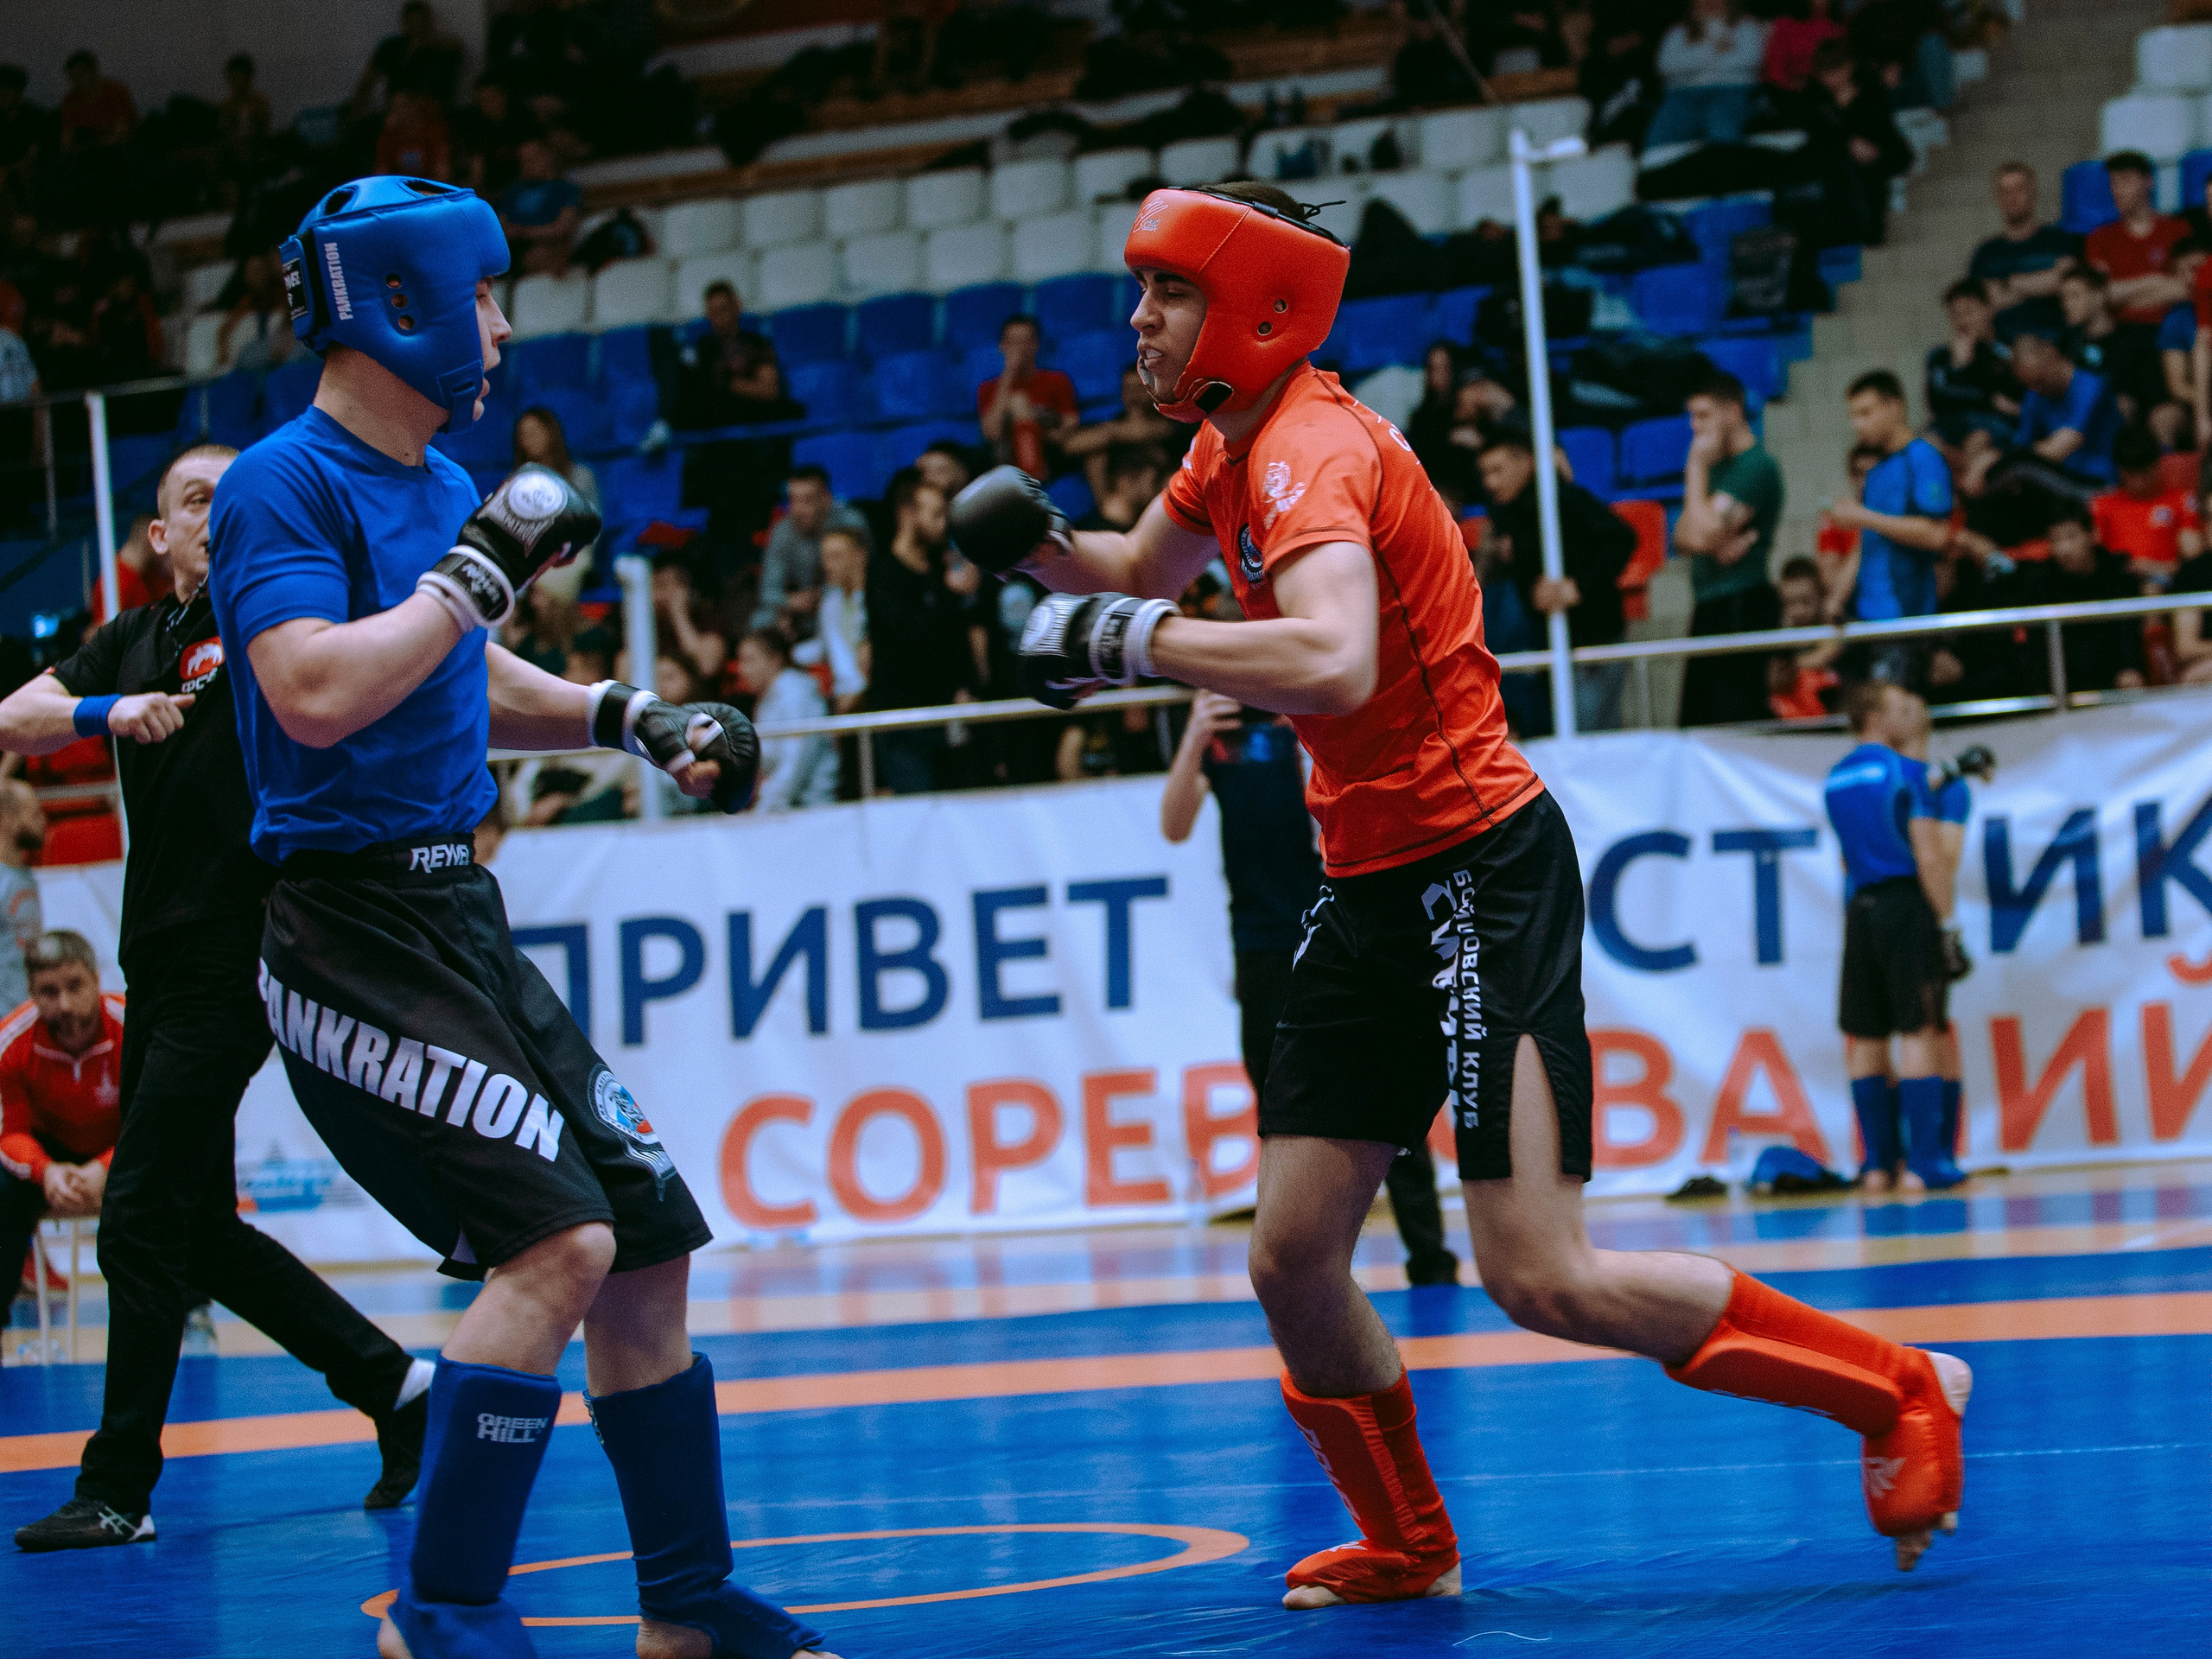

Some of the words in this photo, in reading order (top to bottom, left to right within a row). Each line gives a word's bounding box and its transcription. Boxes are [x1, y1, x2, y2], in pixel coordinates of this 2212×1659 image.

[324, 242, 353, 321] PANKRATION
[510, 874, 1170, 1046] ПРИВЕТ
[1462, 1052, 1480, 1129] КЛУБ
[477, 1413, 549, 1429] GREEN
[477, 1424, 537, 1443] HILL
